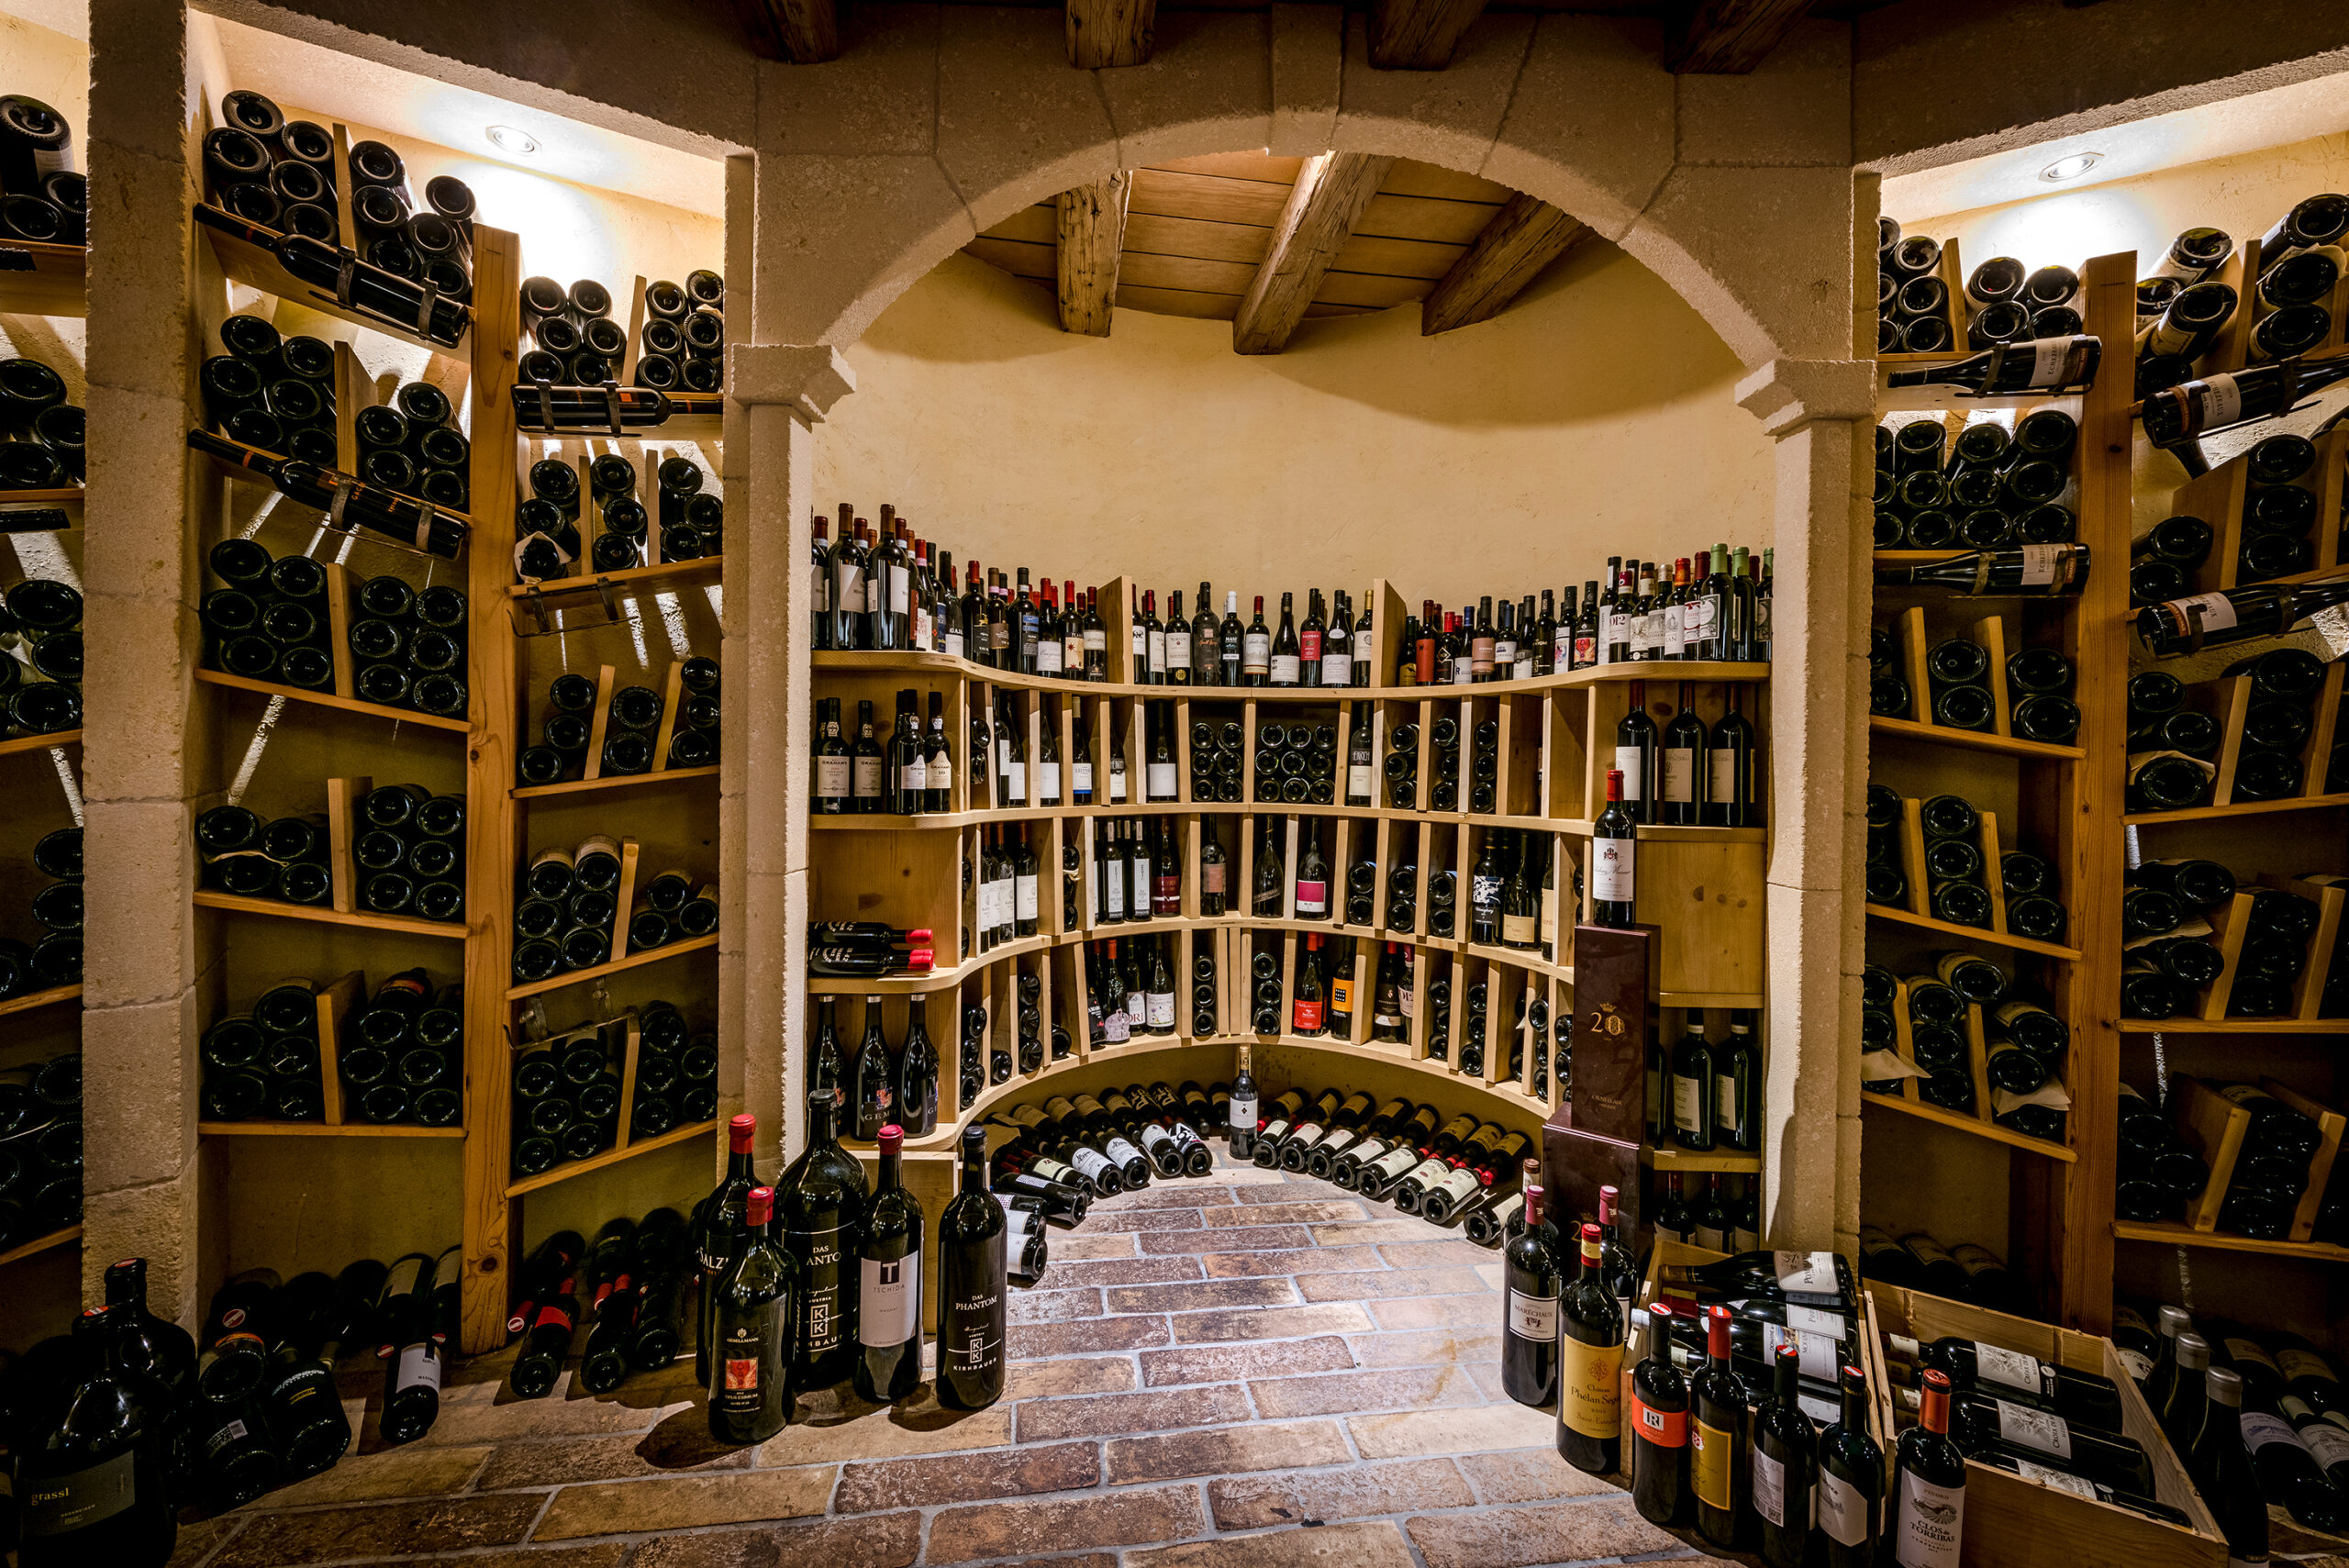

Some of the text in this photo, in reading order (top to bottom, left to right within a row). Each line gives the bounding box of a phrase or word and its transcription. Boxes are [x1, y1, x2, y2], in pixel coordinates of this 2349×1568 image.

[813, 1245, 829, 1254] DAS
[807, 1251, 842, 1266] ANTO
[882, 1262, 898, 1283] T
[874, 1284, 906, 1294] TSCHIDA
[955, 1295, 997, 1311] PHANTOM
[1571, 1385, 1601, 1405] Phélan
[30, 1486, 71, 1507] grassl
[1909, 1521, 1955, 1542] TORRIBAS
[1917, 1519, 1943, 1534] CLOS
